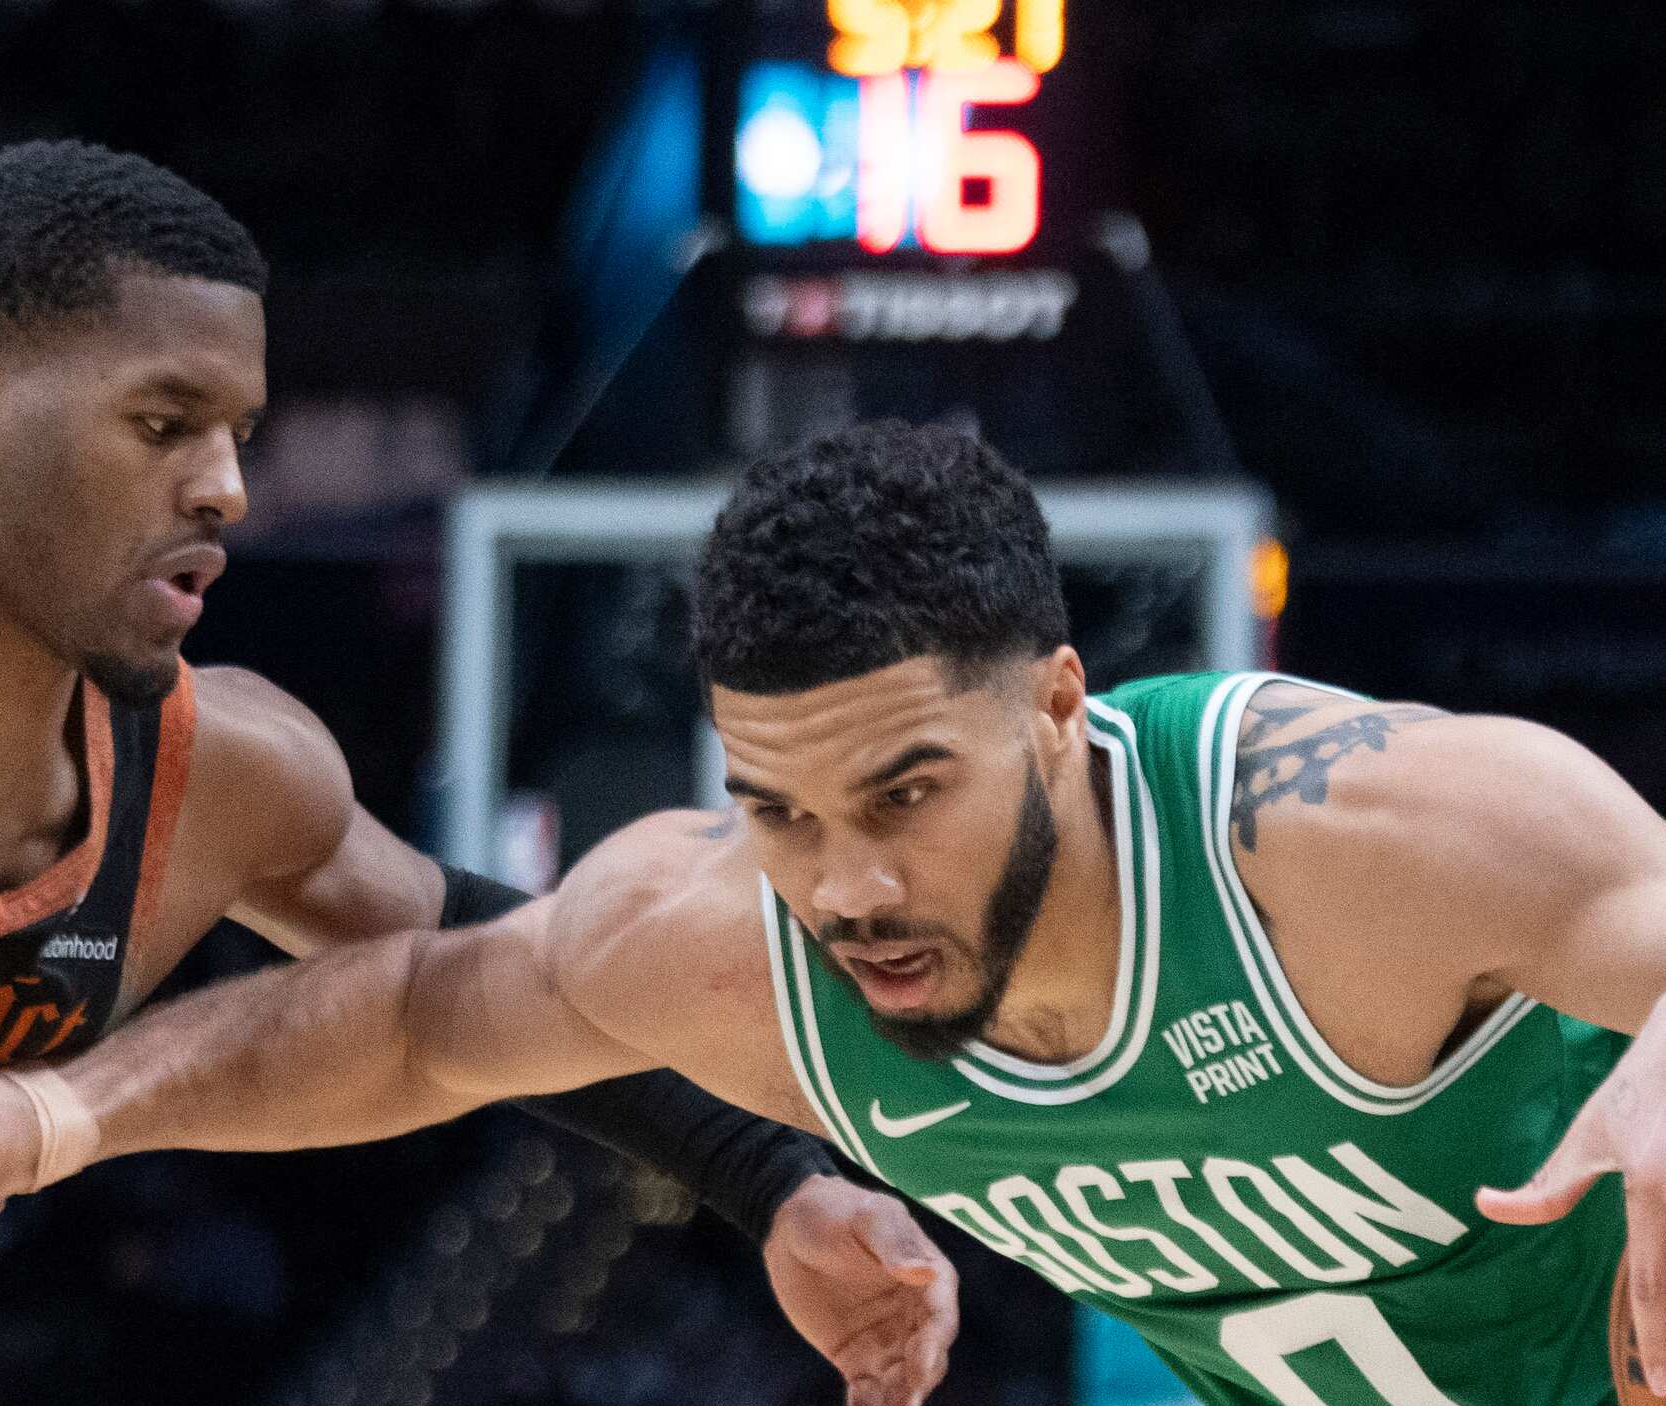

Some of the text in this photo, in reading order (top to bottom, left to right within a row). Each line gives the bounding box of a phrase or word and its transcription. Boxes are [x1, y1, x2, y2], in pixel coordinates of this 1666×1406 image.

[855, 55, 1040, 255] 16
[1162, 1000, 1266, 1068] VISTA
[1186, 1044, 1283, 1104] PRINT
[920, 1141, 1470, 1298] BOSTON
